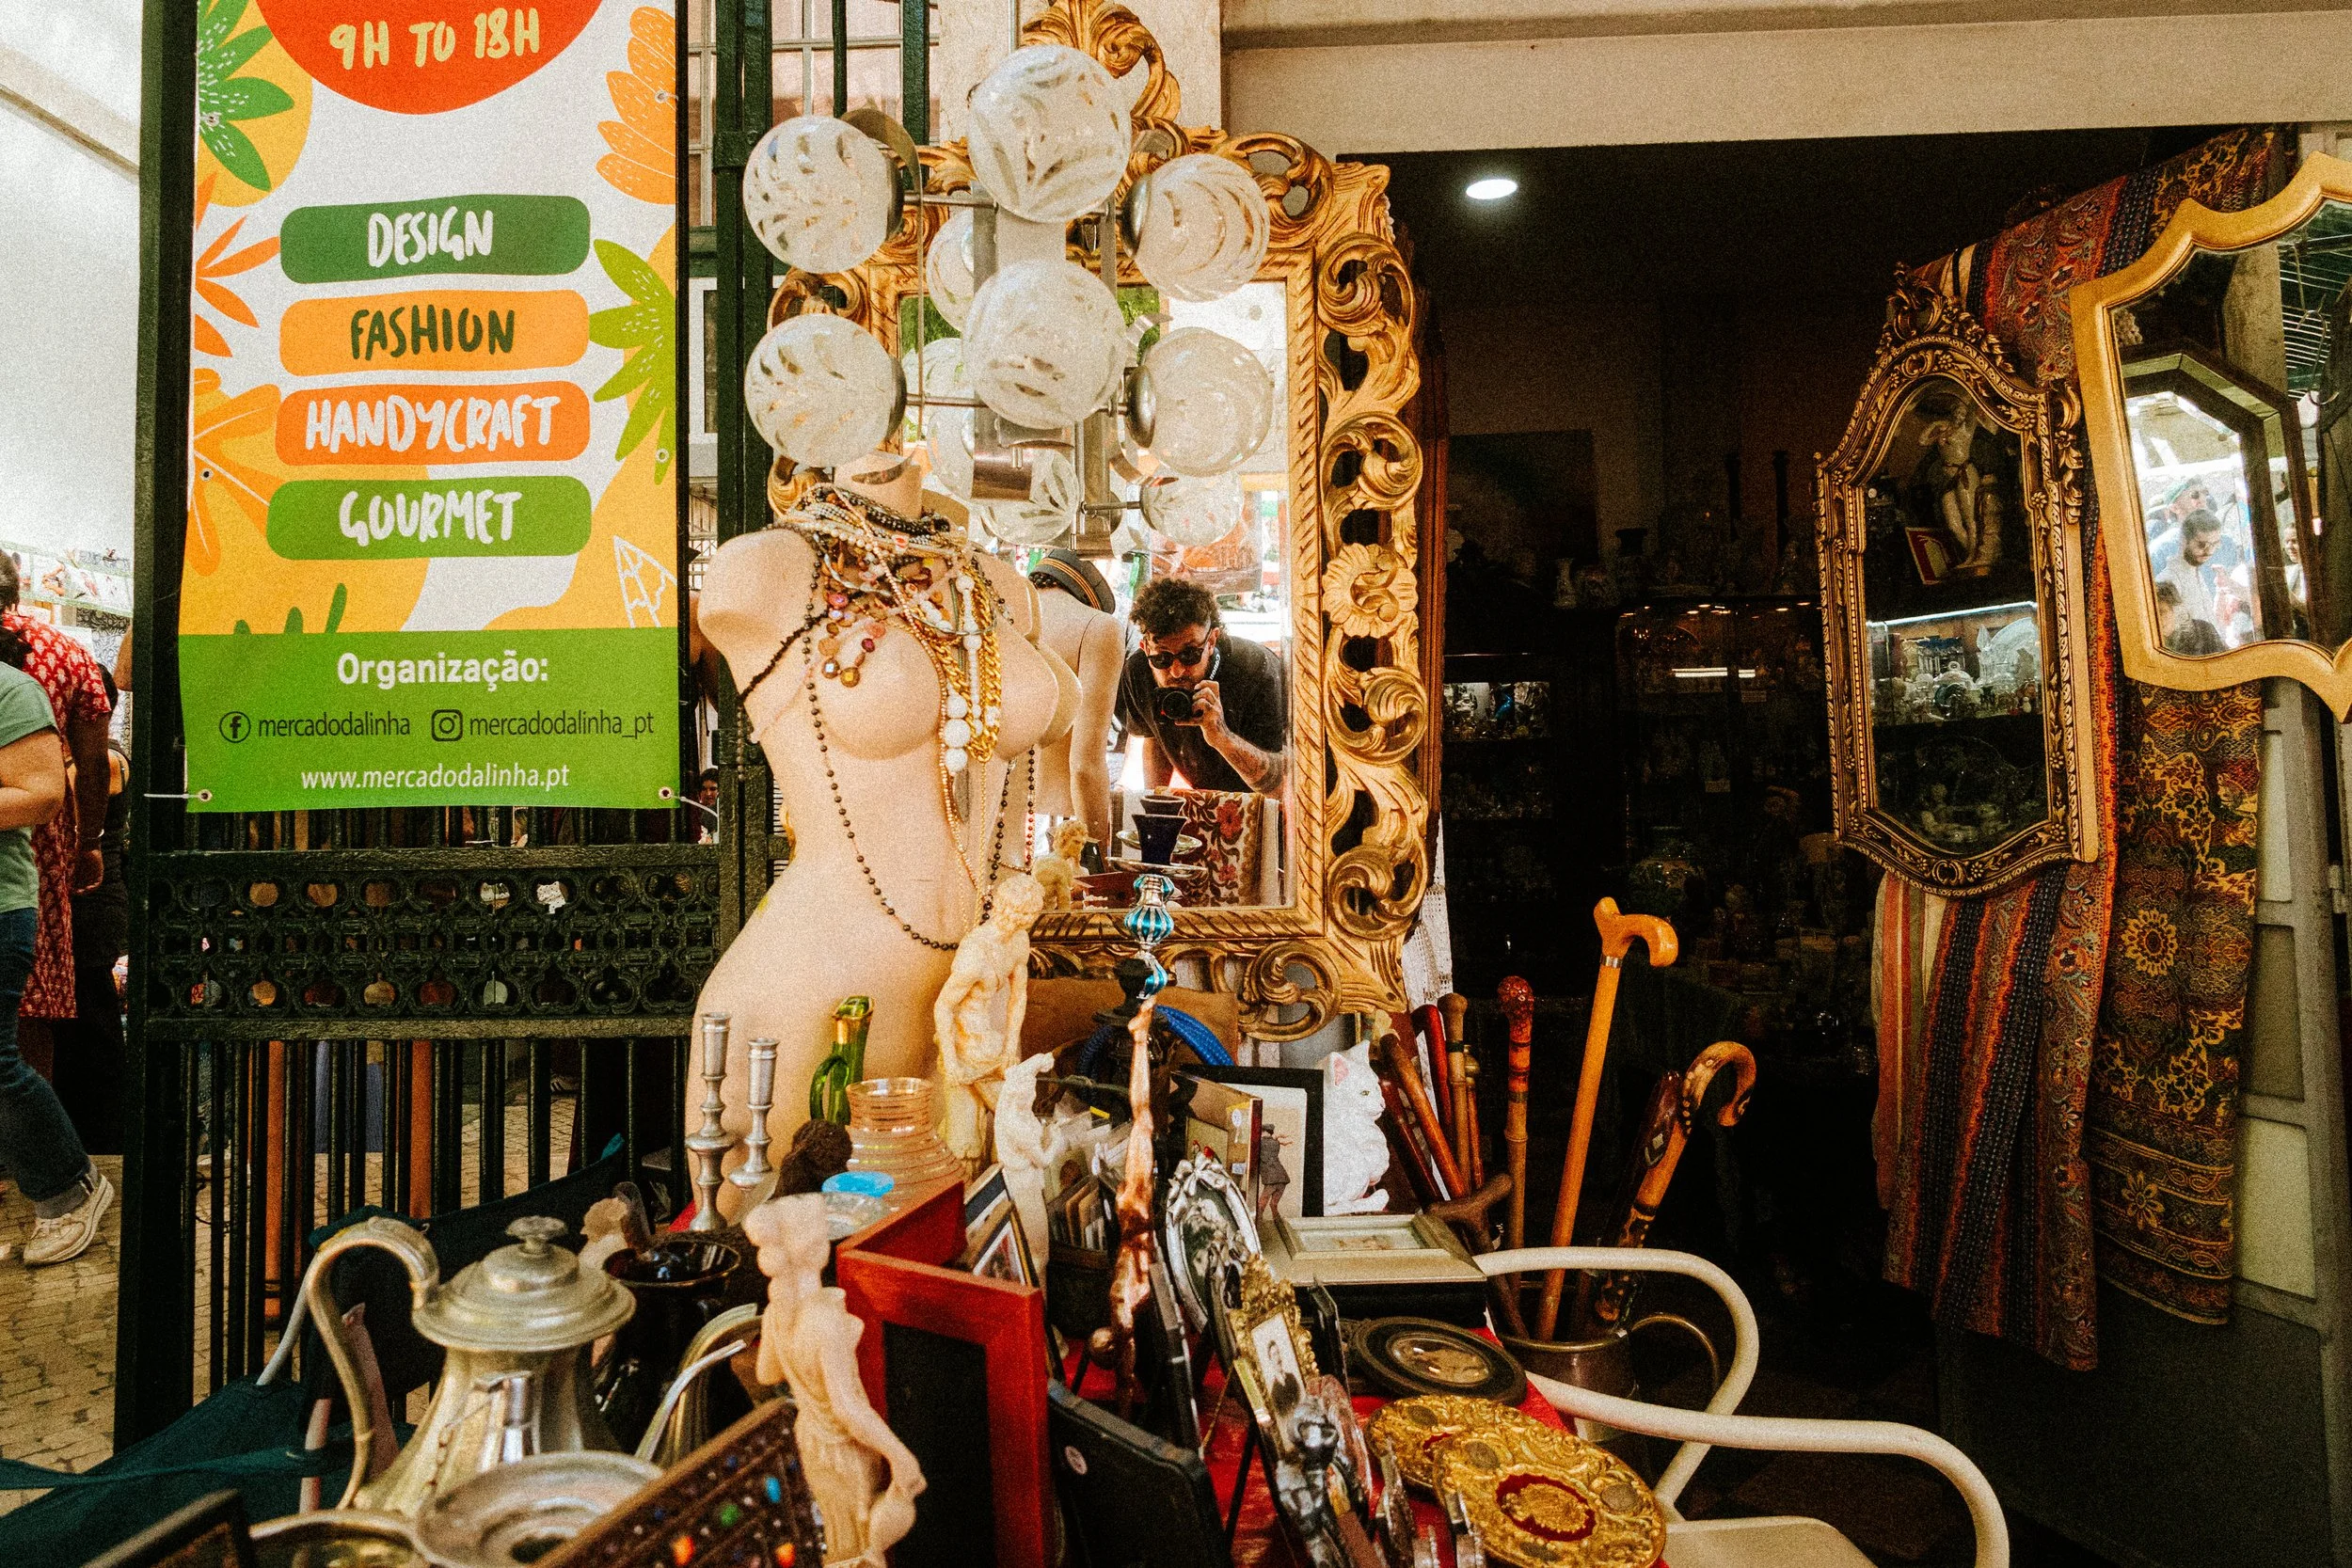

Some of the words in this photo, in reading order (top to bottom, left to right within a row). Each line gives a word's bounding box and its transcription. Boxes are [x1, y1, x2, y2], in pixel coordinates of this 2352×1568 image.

[329, 21, 389, 70] 9H
[408, 21, 456, 68] TO
[474, 8, 540, 59] 18H
[368, 206, 493, 268] DESIGN
[351, 304, 515, 361] FASHION
[306, 394, 561, 453] HANDYCRAFT
[340, 489, 522, 546] GOURMET
[338, 649, 548, 691] Organização:
[259, 710, 410, 736] mercadodalinha
[470, 709, 654, 739] mercadodalinha_pt
[301, 762, 570, 792] www.mercadodalinha.pt
